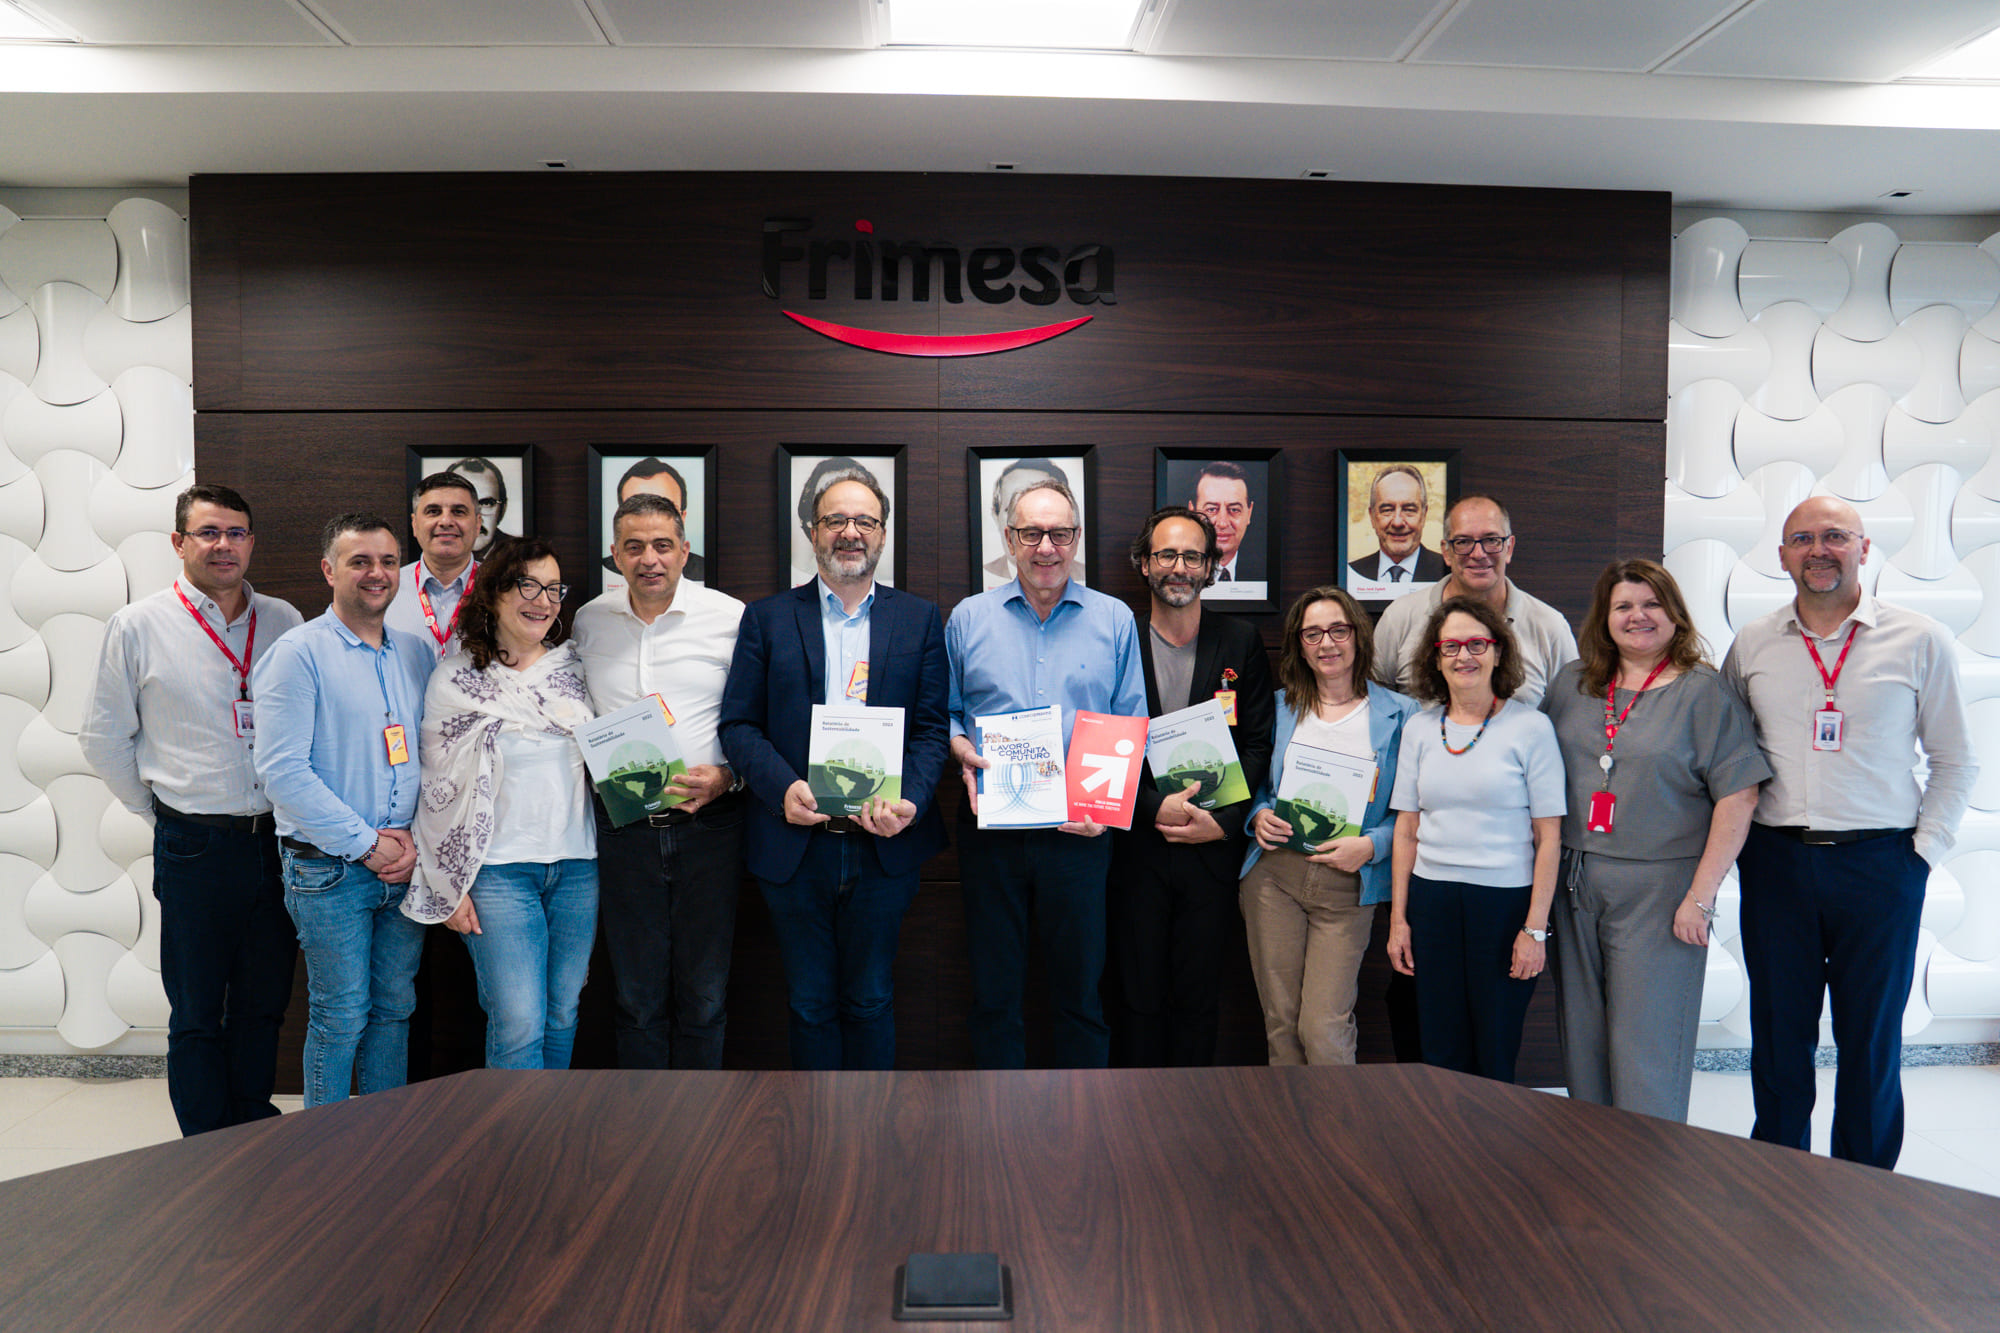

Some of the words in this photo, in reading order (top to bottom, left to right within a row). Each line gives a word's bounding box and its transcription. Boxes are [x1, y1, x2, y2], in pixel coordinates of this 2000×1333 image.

[761, 218, 1118, 306] Frimesa
[990, 742, 1030, 752] LAVORO
[1010, 751, 1051, 762] FUTURO
